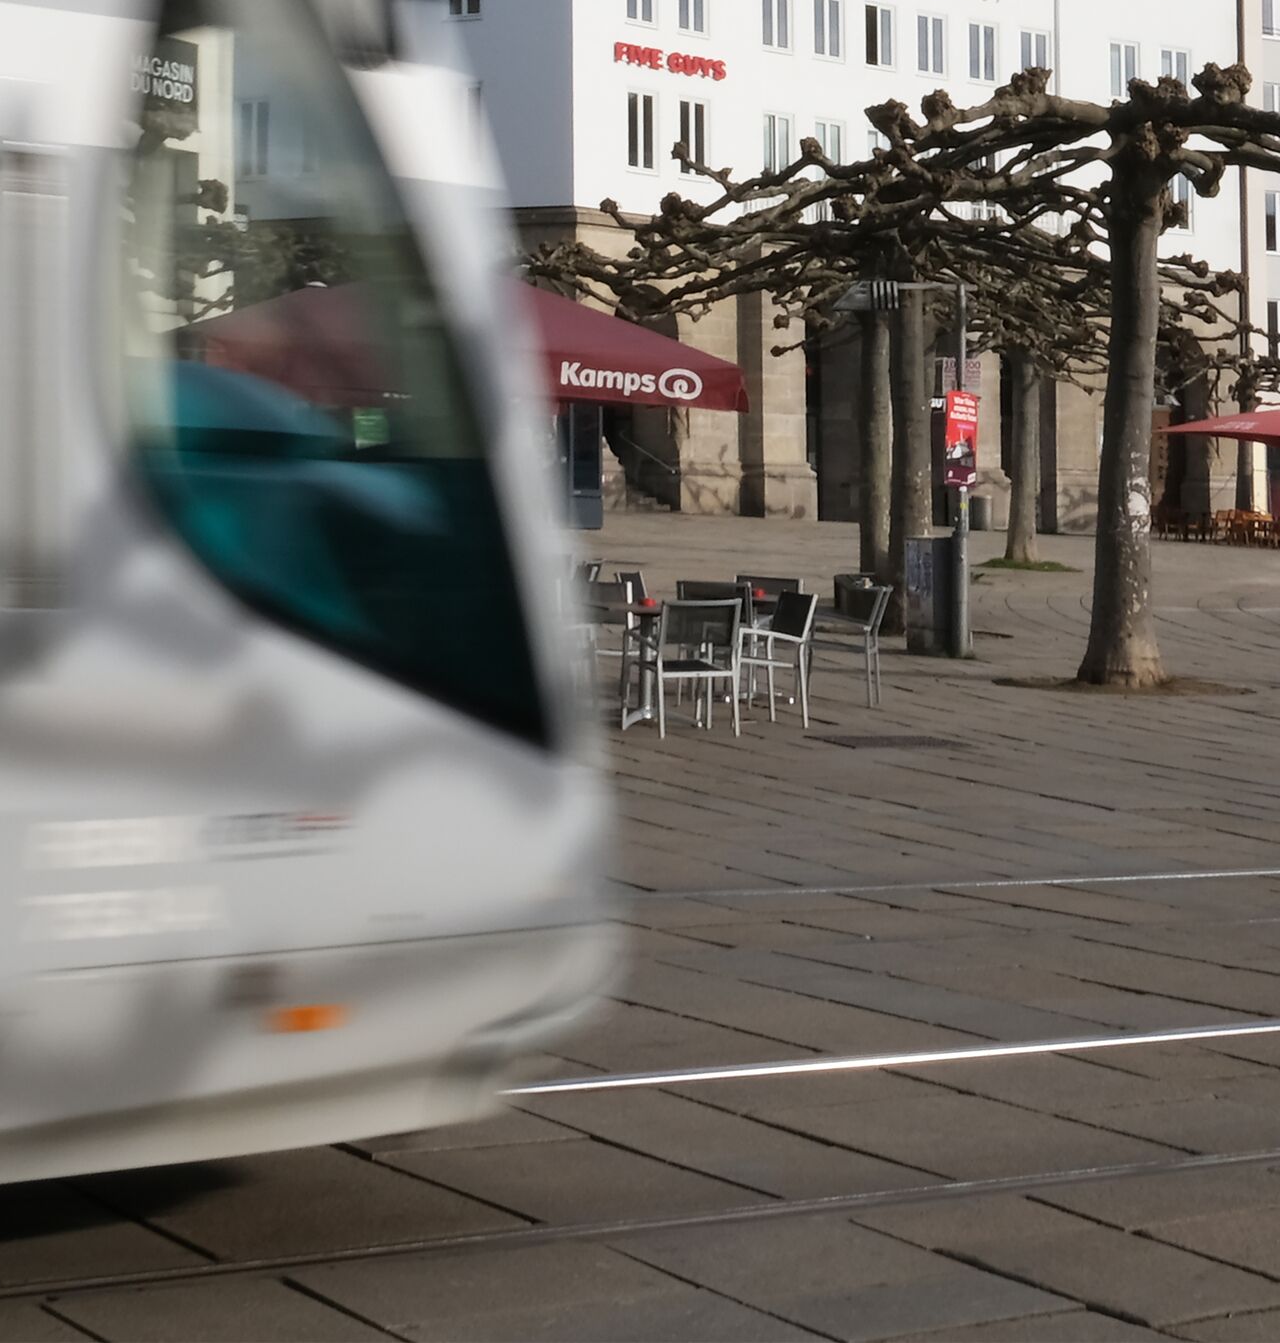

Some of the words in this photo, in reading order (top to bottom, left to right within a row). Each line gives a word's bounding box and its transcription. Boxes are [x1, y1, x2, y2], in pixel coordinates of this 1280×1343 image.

[614, 42, 663, 70] FIVE
[667, 52, 726, 81] GUYS
[153, 78, 193, 102] NORD
[561, 361, 656, 397] Kamps
